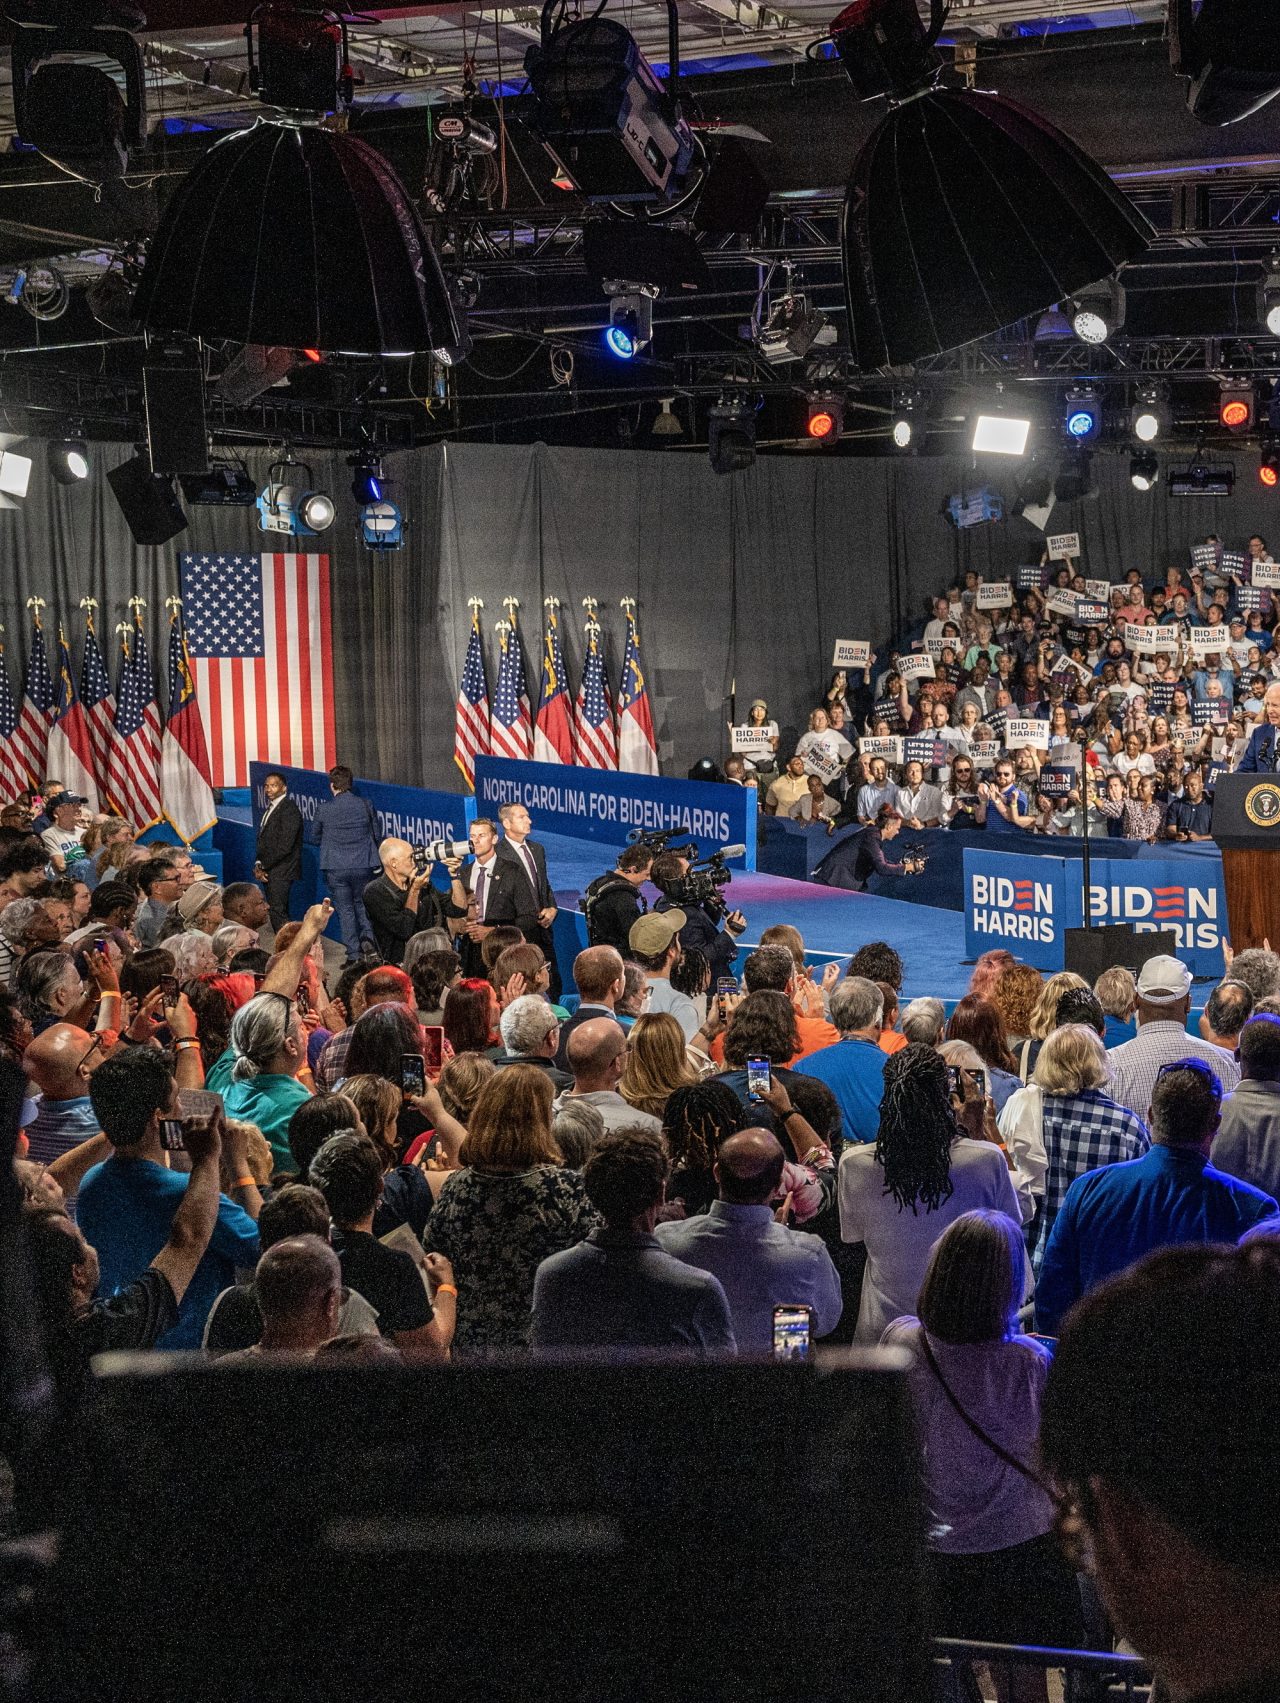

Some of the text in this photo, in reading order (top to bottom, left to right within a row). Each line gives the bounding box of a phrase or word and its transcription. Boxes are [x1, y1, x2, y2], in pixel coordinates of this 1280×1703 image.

[1050, 536, 1077, 546] BIDEN
[1051, 542, 1077, 551] HARRIS
[980, 586, 1008, 594] BIDEN
[1079, 605, 1107, 614] BIDEN
[1079, 611, 1107, 619] HARRIS
[1127, 624, 1152, 637] BIDEN
[1194, 629, 1224, 638] BIDEN
[1126, 632, 1152, 643] HARRIS
[1194, 636, 1225, 644] HARRIS
[839, 647, 866, 655] BIDEN
[898, 657, 928, 668] BIDEN
[899, 663, 930, 673] HARRIS
[1010, 722, 1044, 730] BIDEN
[863, 739, 896, 747] BIDEN
[1041, 774, 1070, 783] BIDEN
[1041, 782, 1070, 791] HARRIS
[483, 778, 730, 842] NORTH CAROLINA FOR BIDEN-HARRIS
[378, 811, 454, 846] DEN-HARRIS
[973, 875, 1053, 914] BIDEN
[1082, 886, 1217, 918] BIDEN
[974, 908, 1055, 942] HARRIS
